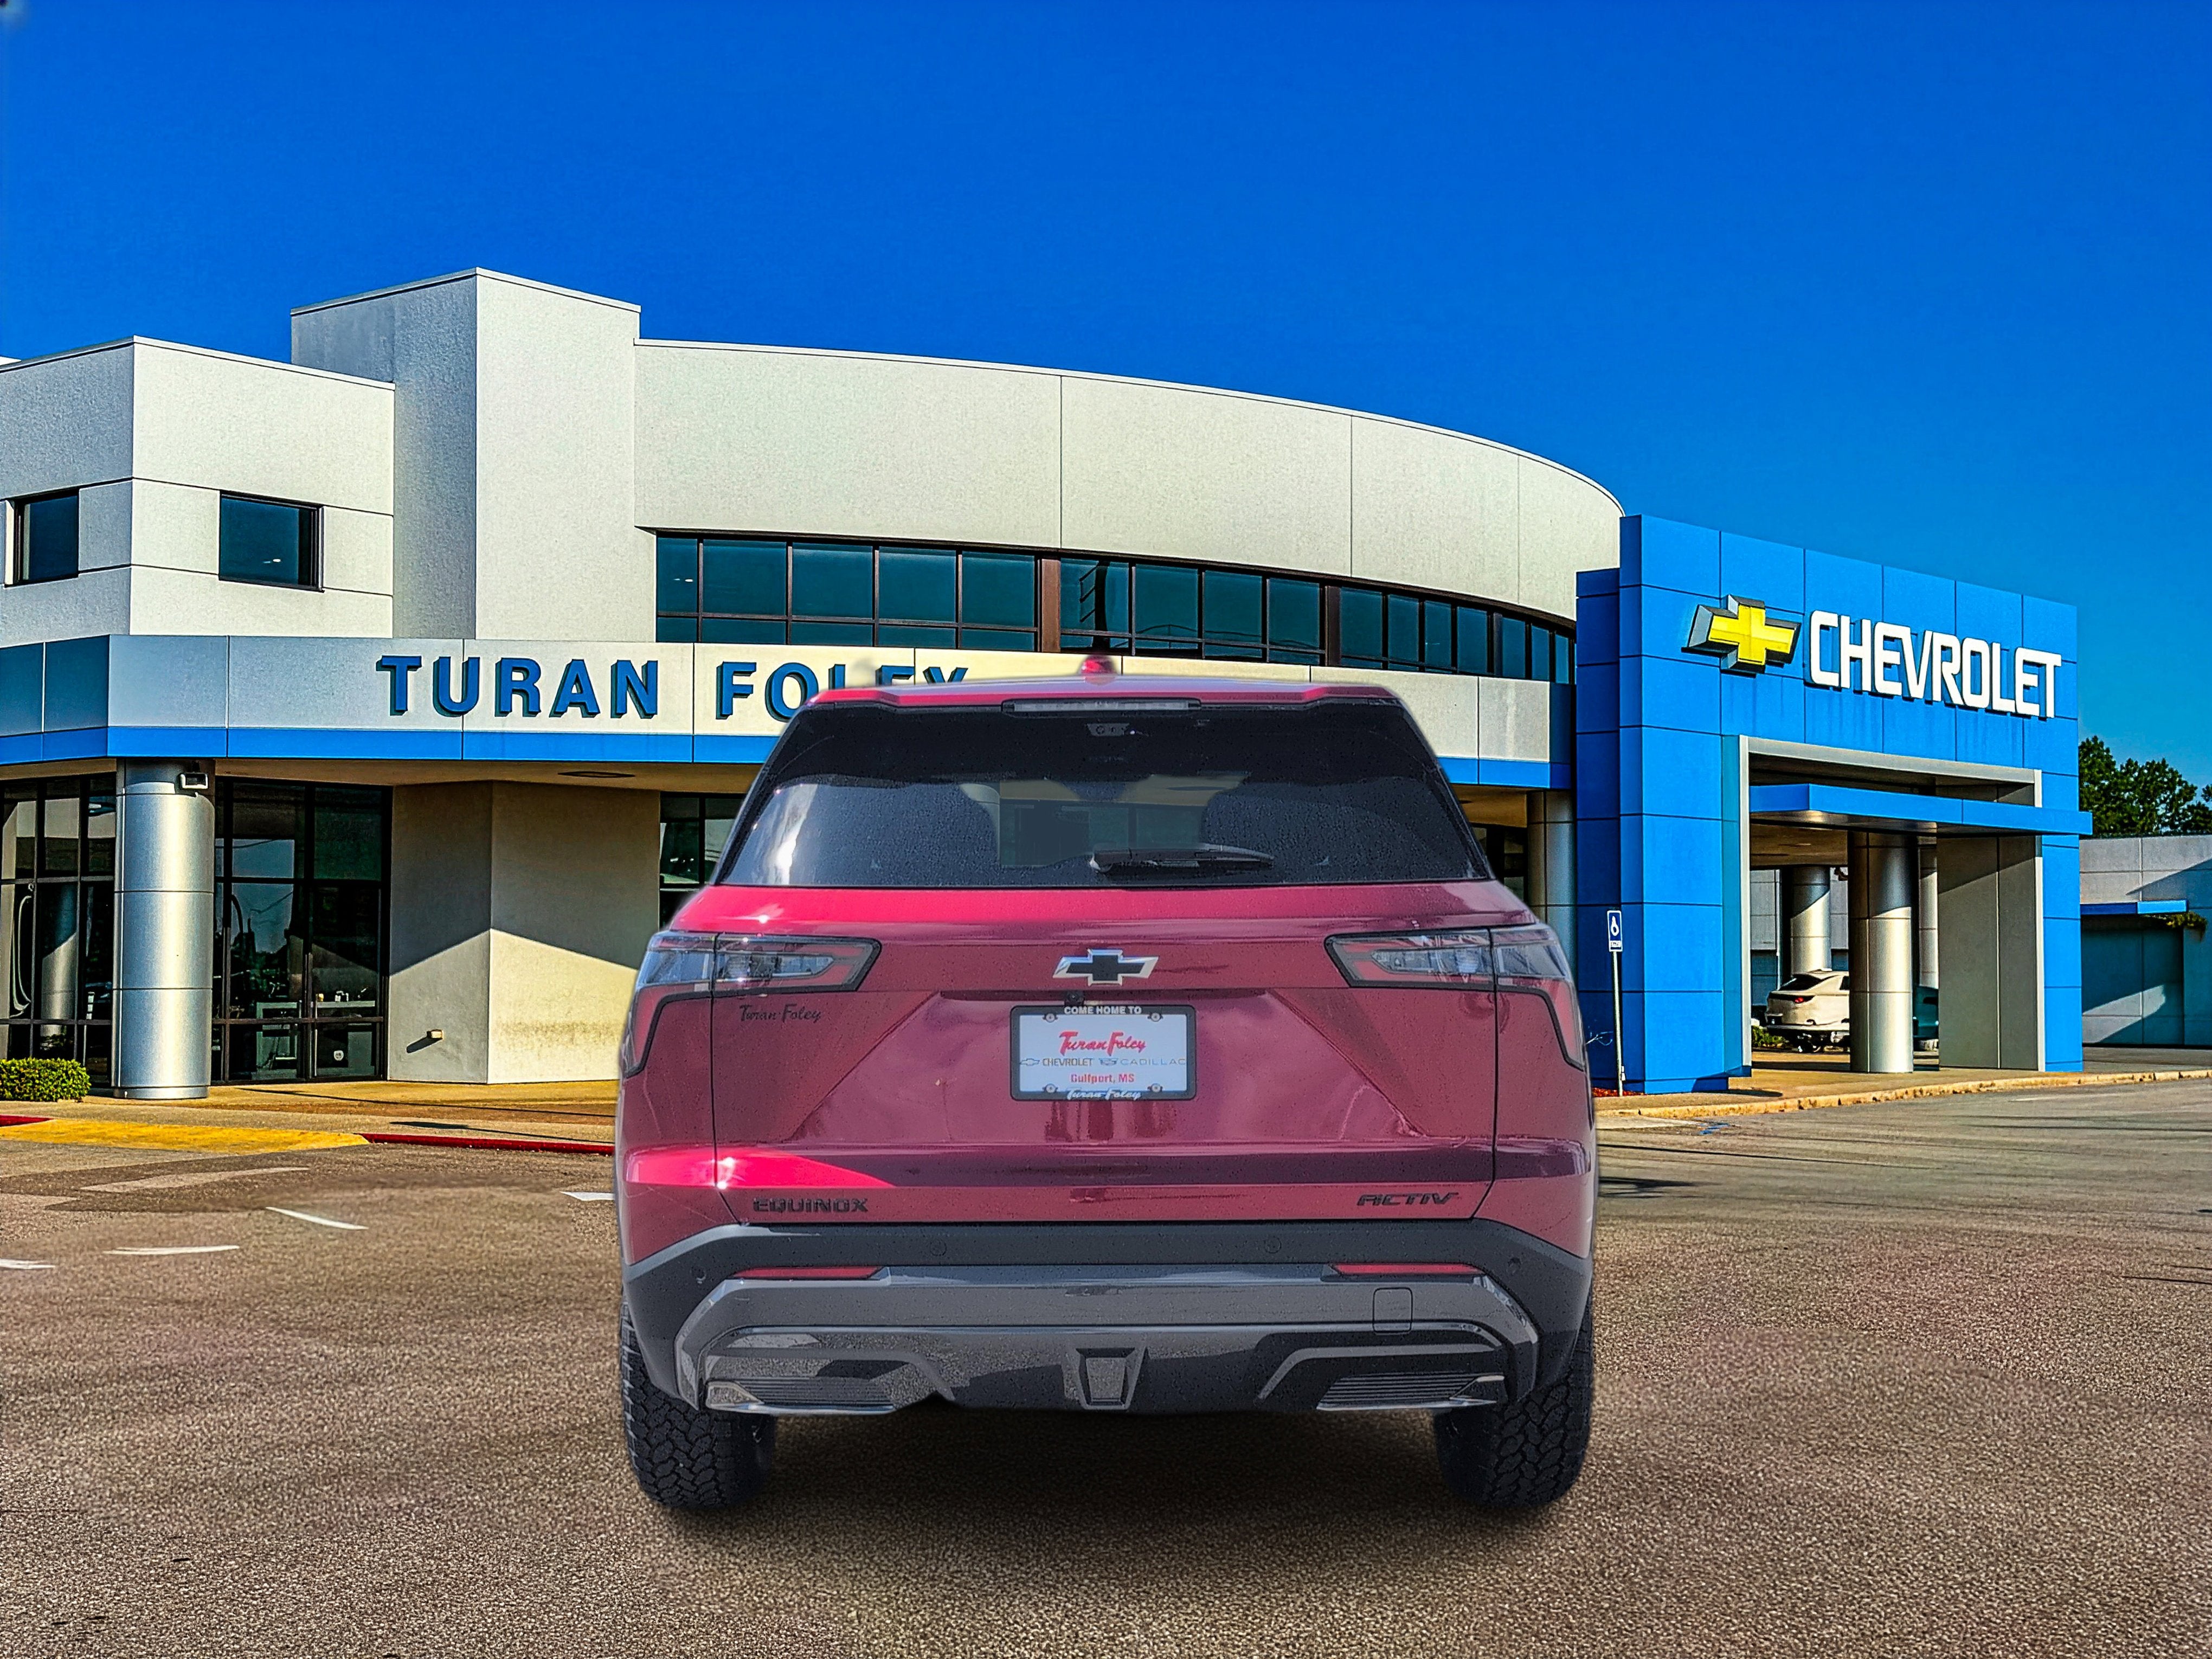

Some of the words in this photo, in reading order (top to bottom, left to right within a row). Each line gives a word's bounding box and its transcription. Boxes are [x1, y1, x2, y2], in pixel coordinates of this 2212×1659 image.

[1810, 610, 2062, 719] CHEVROLET
[376, 655, 659, 719] TURAN
[782, 1004, 821, 1023] Foley
[1064, 1006, 1094, 1014] COME
[1096, 1006, 1126, 1014] HOME
[1128, 1006, 1142, 1014] TO
[1042, 1058, 1092, 1066] CHEVROLET
[1071, 1074, 1116, 1084] Gulfport,
[1118, 1074, 1134, 1083] MS
[753, 1198, 868, 1212] EQUINOX
[1357, 1192, 1458, 1206] ACTIV
